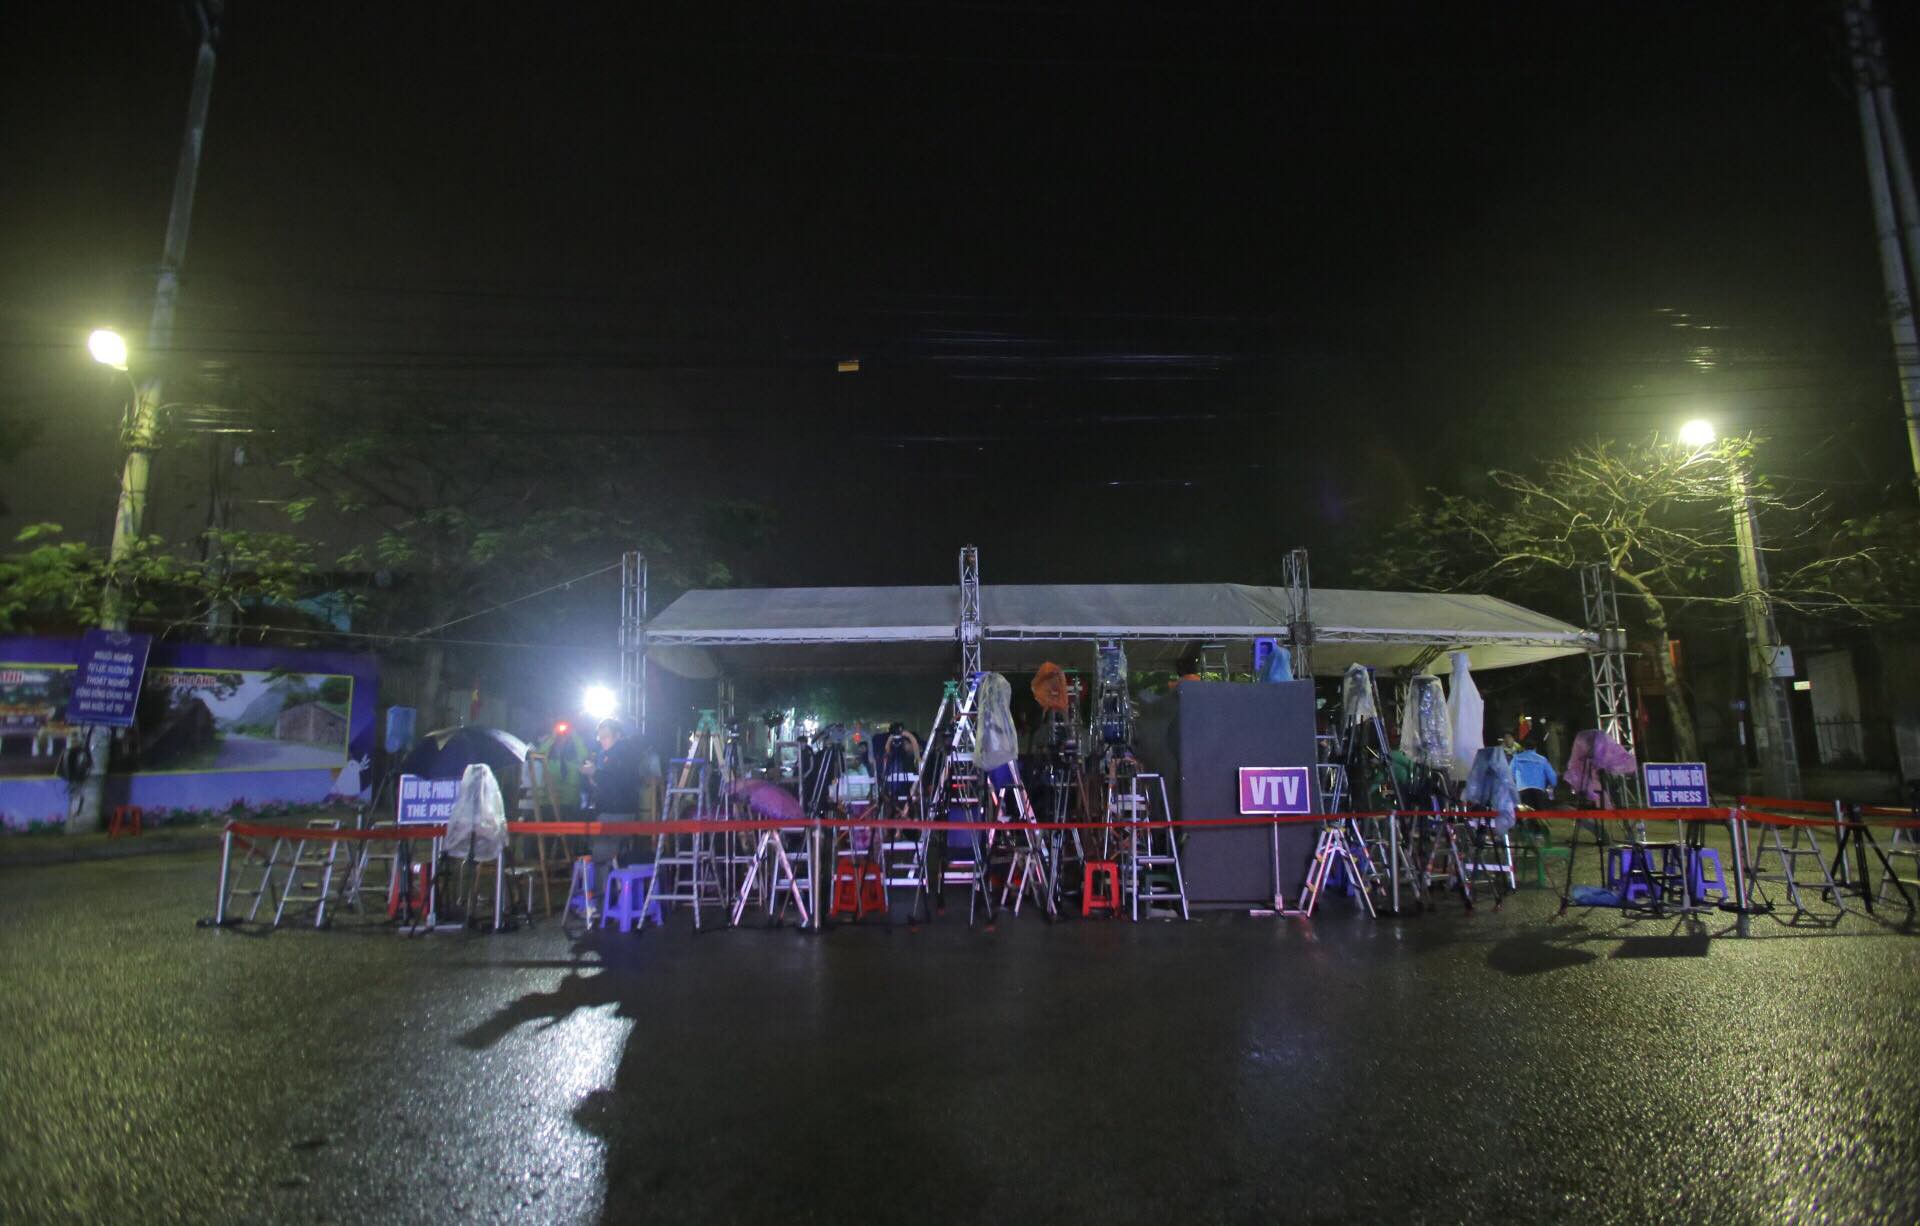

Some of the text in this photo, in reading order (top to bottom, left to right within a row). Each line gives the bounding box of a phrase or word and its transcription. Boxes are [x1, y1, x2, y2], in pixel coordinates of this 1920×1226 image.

[1249, 776, 1299, 806] VTV
[1652, 790, 1701, 803] THE PRESS
[407, 803, 456, 818] THE PRE
